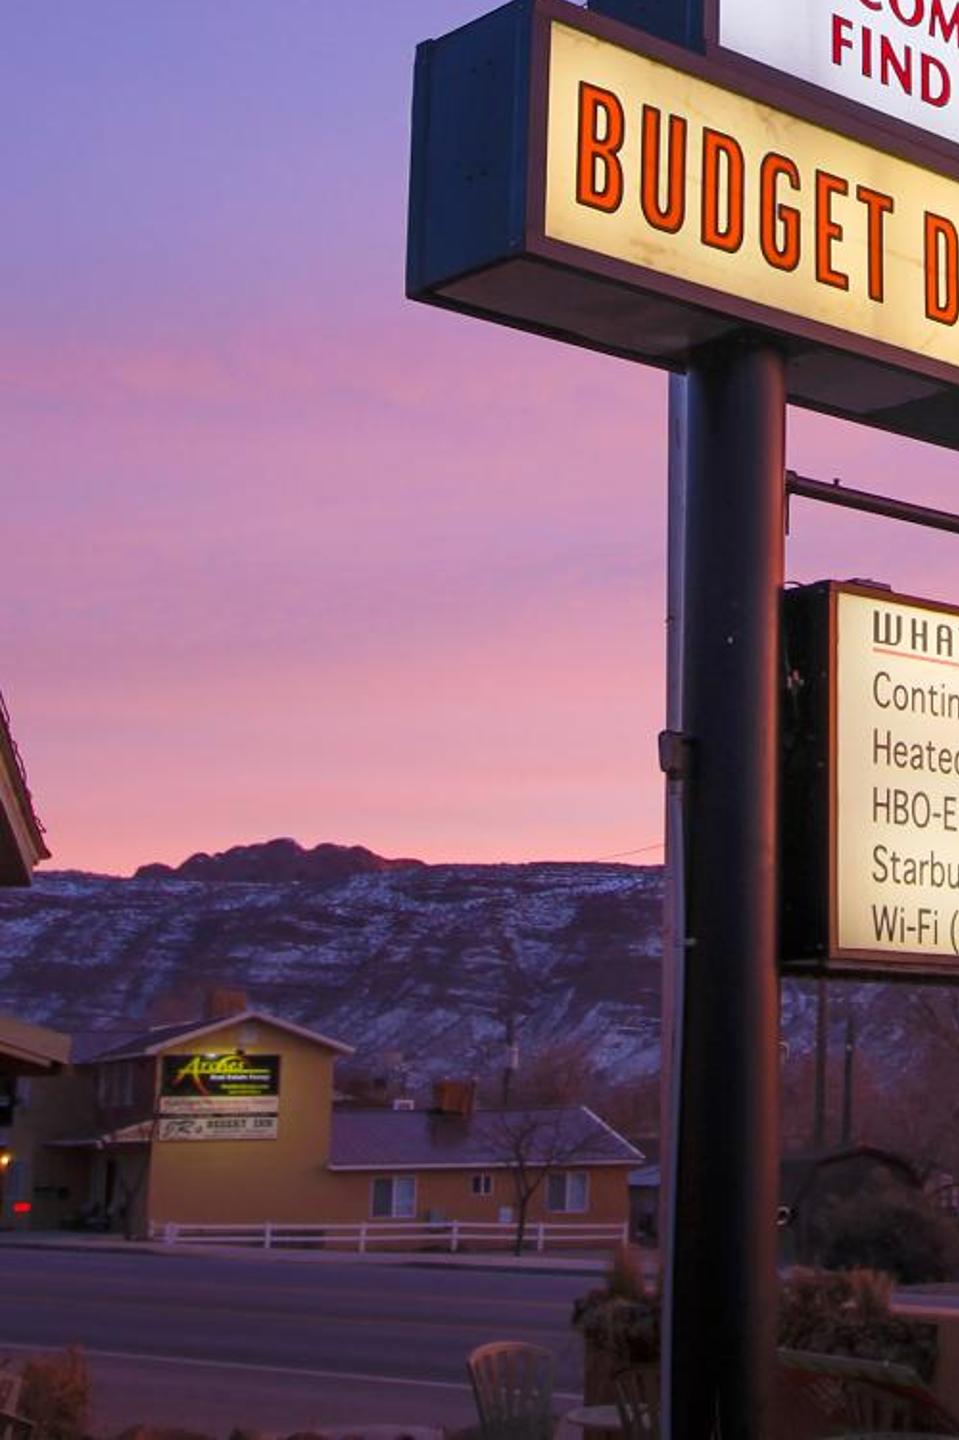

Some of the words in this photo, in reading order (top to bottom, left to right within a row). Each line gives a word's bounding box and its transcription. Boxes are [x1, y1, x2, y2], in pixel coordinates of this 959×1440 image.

[831, 13, 952, 108] FIND
[575, 80, 894, 303] BUDGET
[871, 904, 939, 944] Wi-Fi
